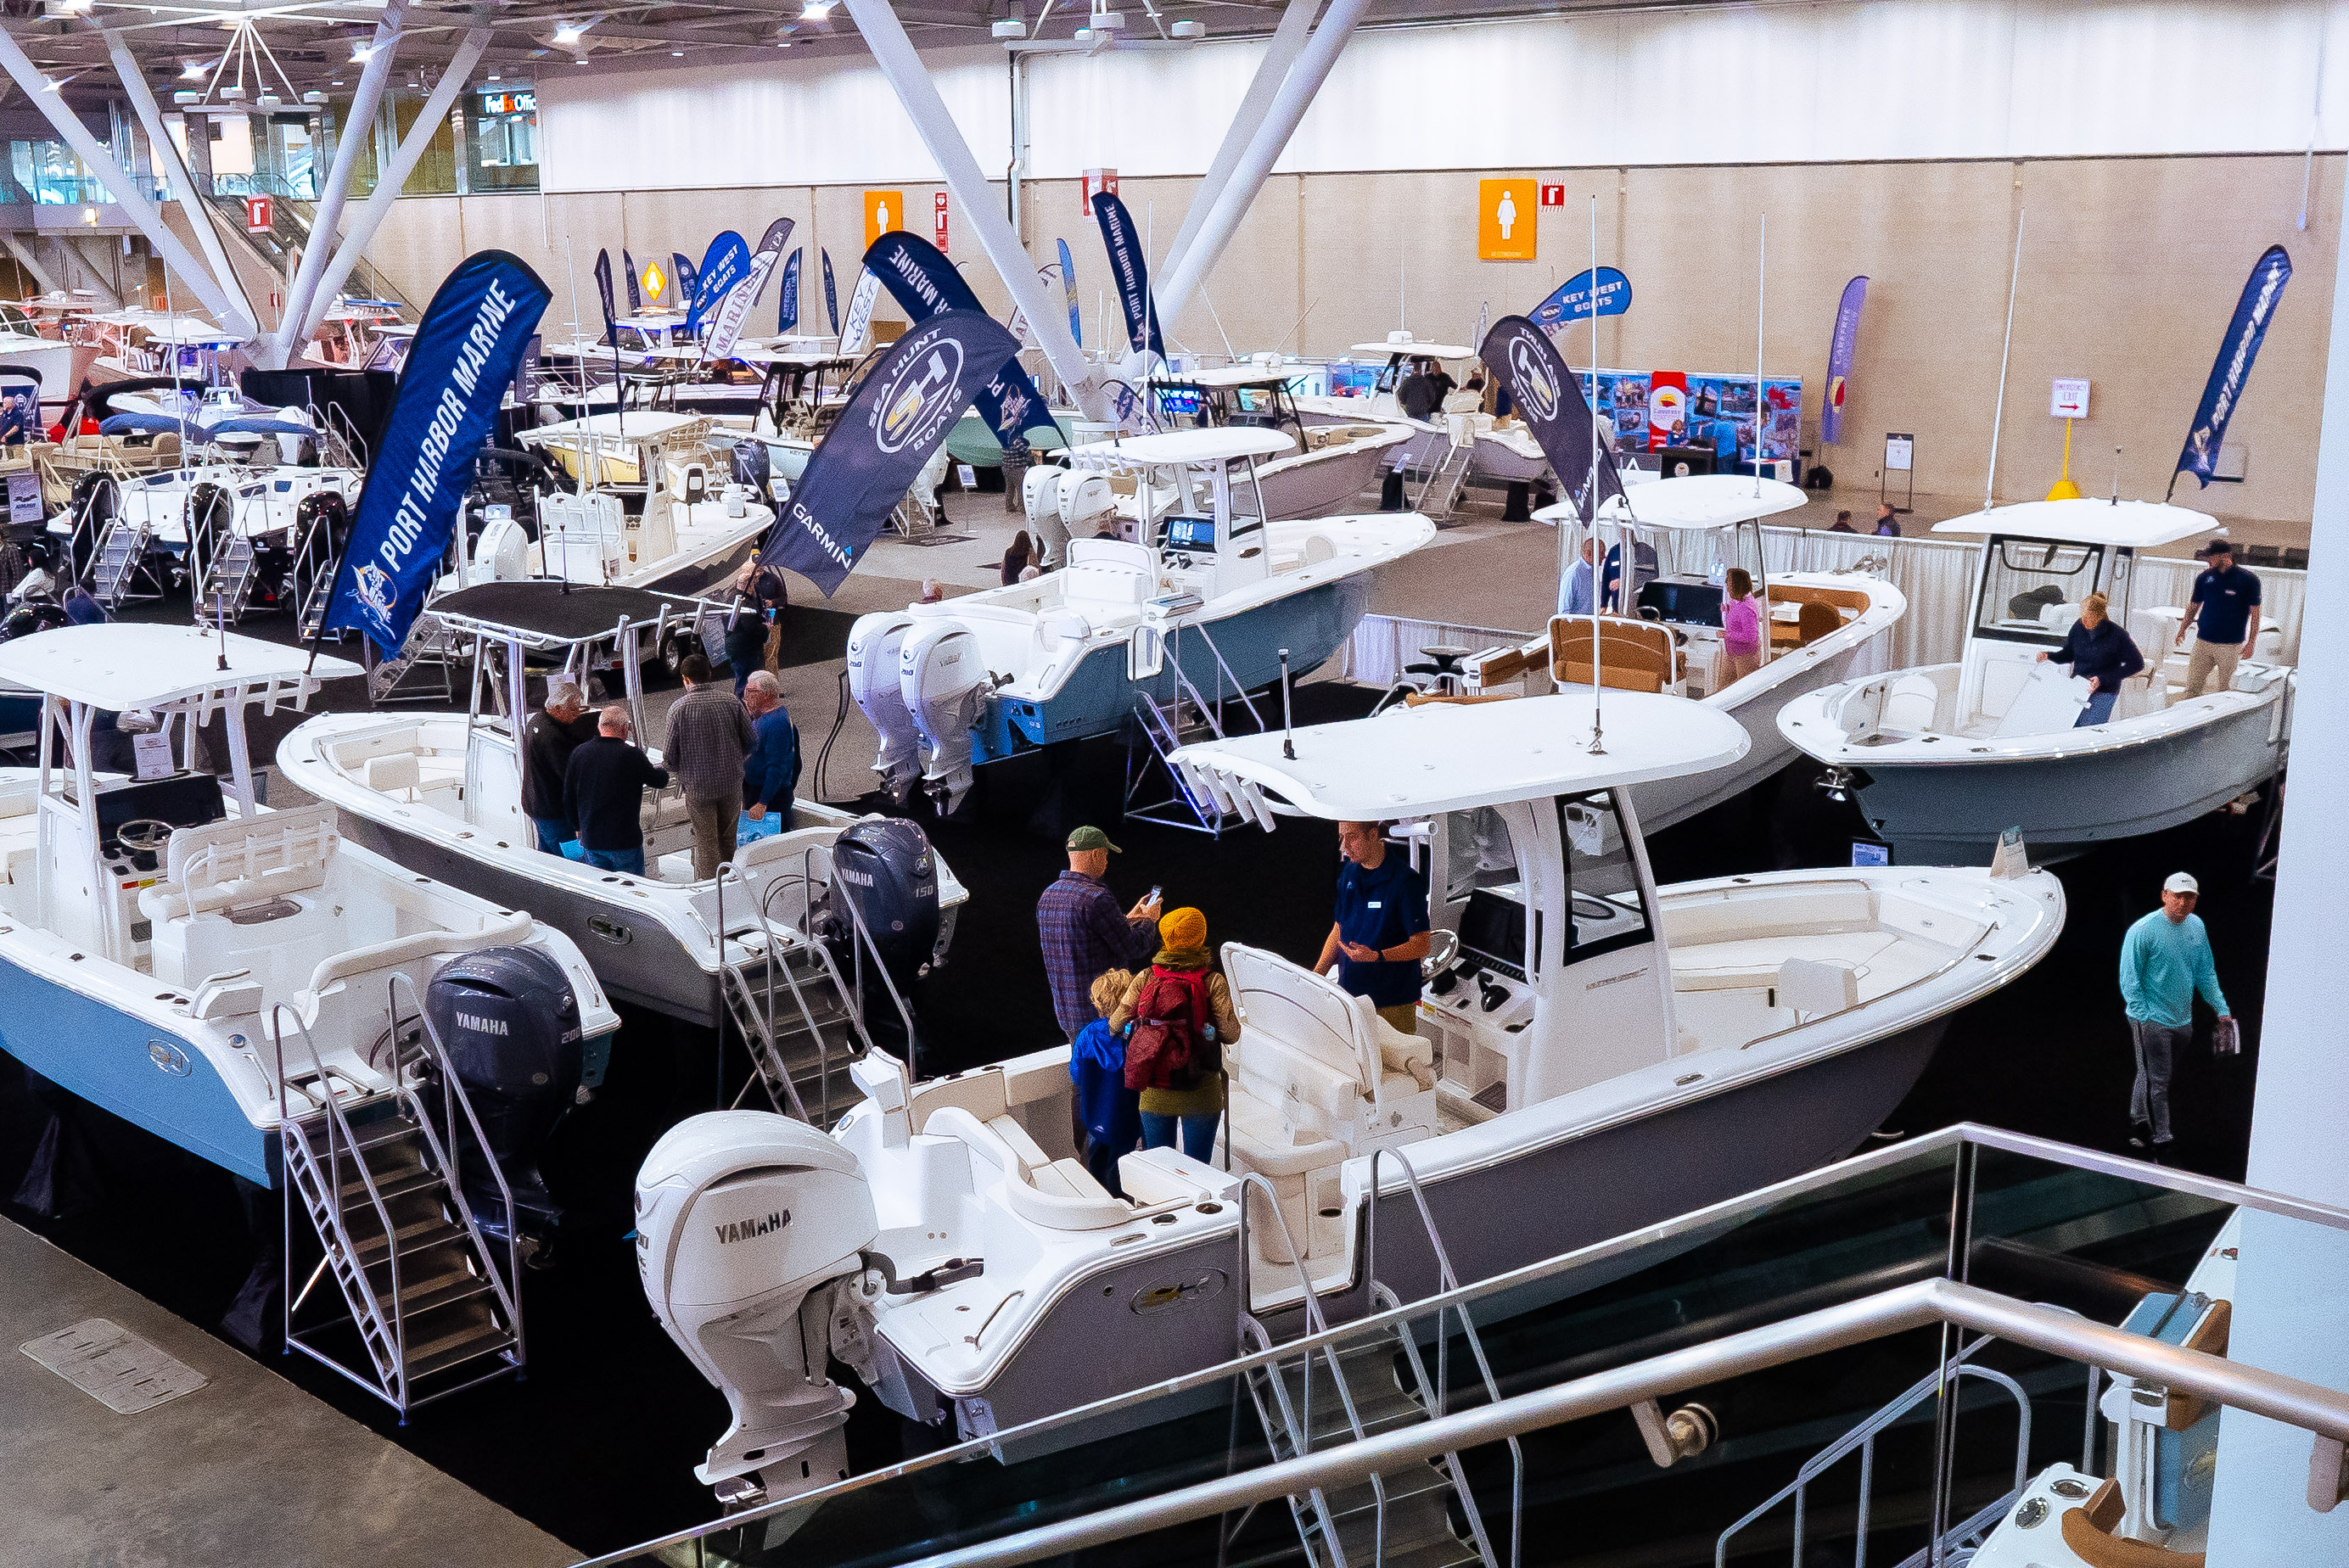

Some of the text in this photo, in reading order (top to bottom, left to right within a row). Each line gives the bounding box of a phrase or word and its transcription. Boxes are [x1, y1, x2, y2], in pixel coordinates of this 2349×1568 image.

[513, 94, 536, 111] Offic
[1105, 203, 1125, 247] MARINE
[647, 272, 660, 290] A
[702, 244, 738, 290] KEY WEST
[713, 265, 737, 293] BOATS
[889, 244, 939, 306] MARINE
[1128, 293, 1143, 320] PORT
[1562, 291, 1585, 304] KEY
[868, 328, 941, 428] SEA HUNT
[380, 278, 516, 572] PORT HARBOR MARINE
[912, 387, 962, 451] BOATS
[793, 503, 852, 570] GARMIN
[840, 867, 874, 888] YAMAHA
[915, 885, 933, 899] 150
[457, 1011, 509, 1036] YAMAHA
[561, 1026, 582, 1044] 200
[715, 1207, 793, 1244] YAMAHA
